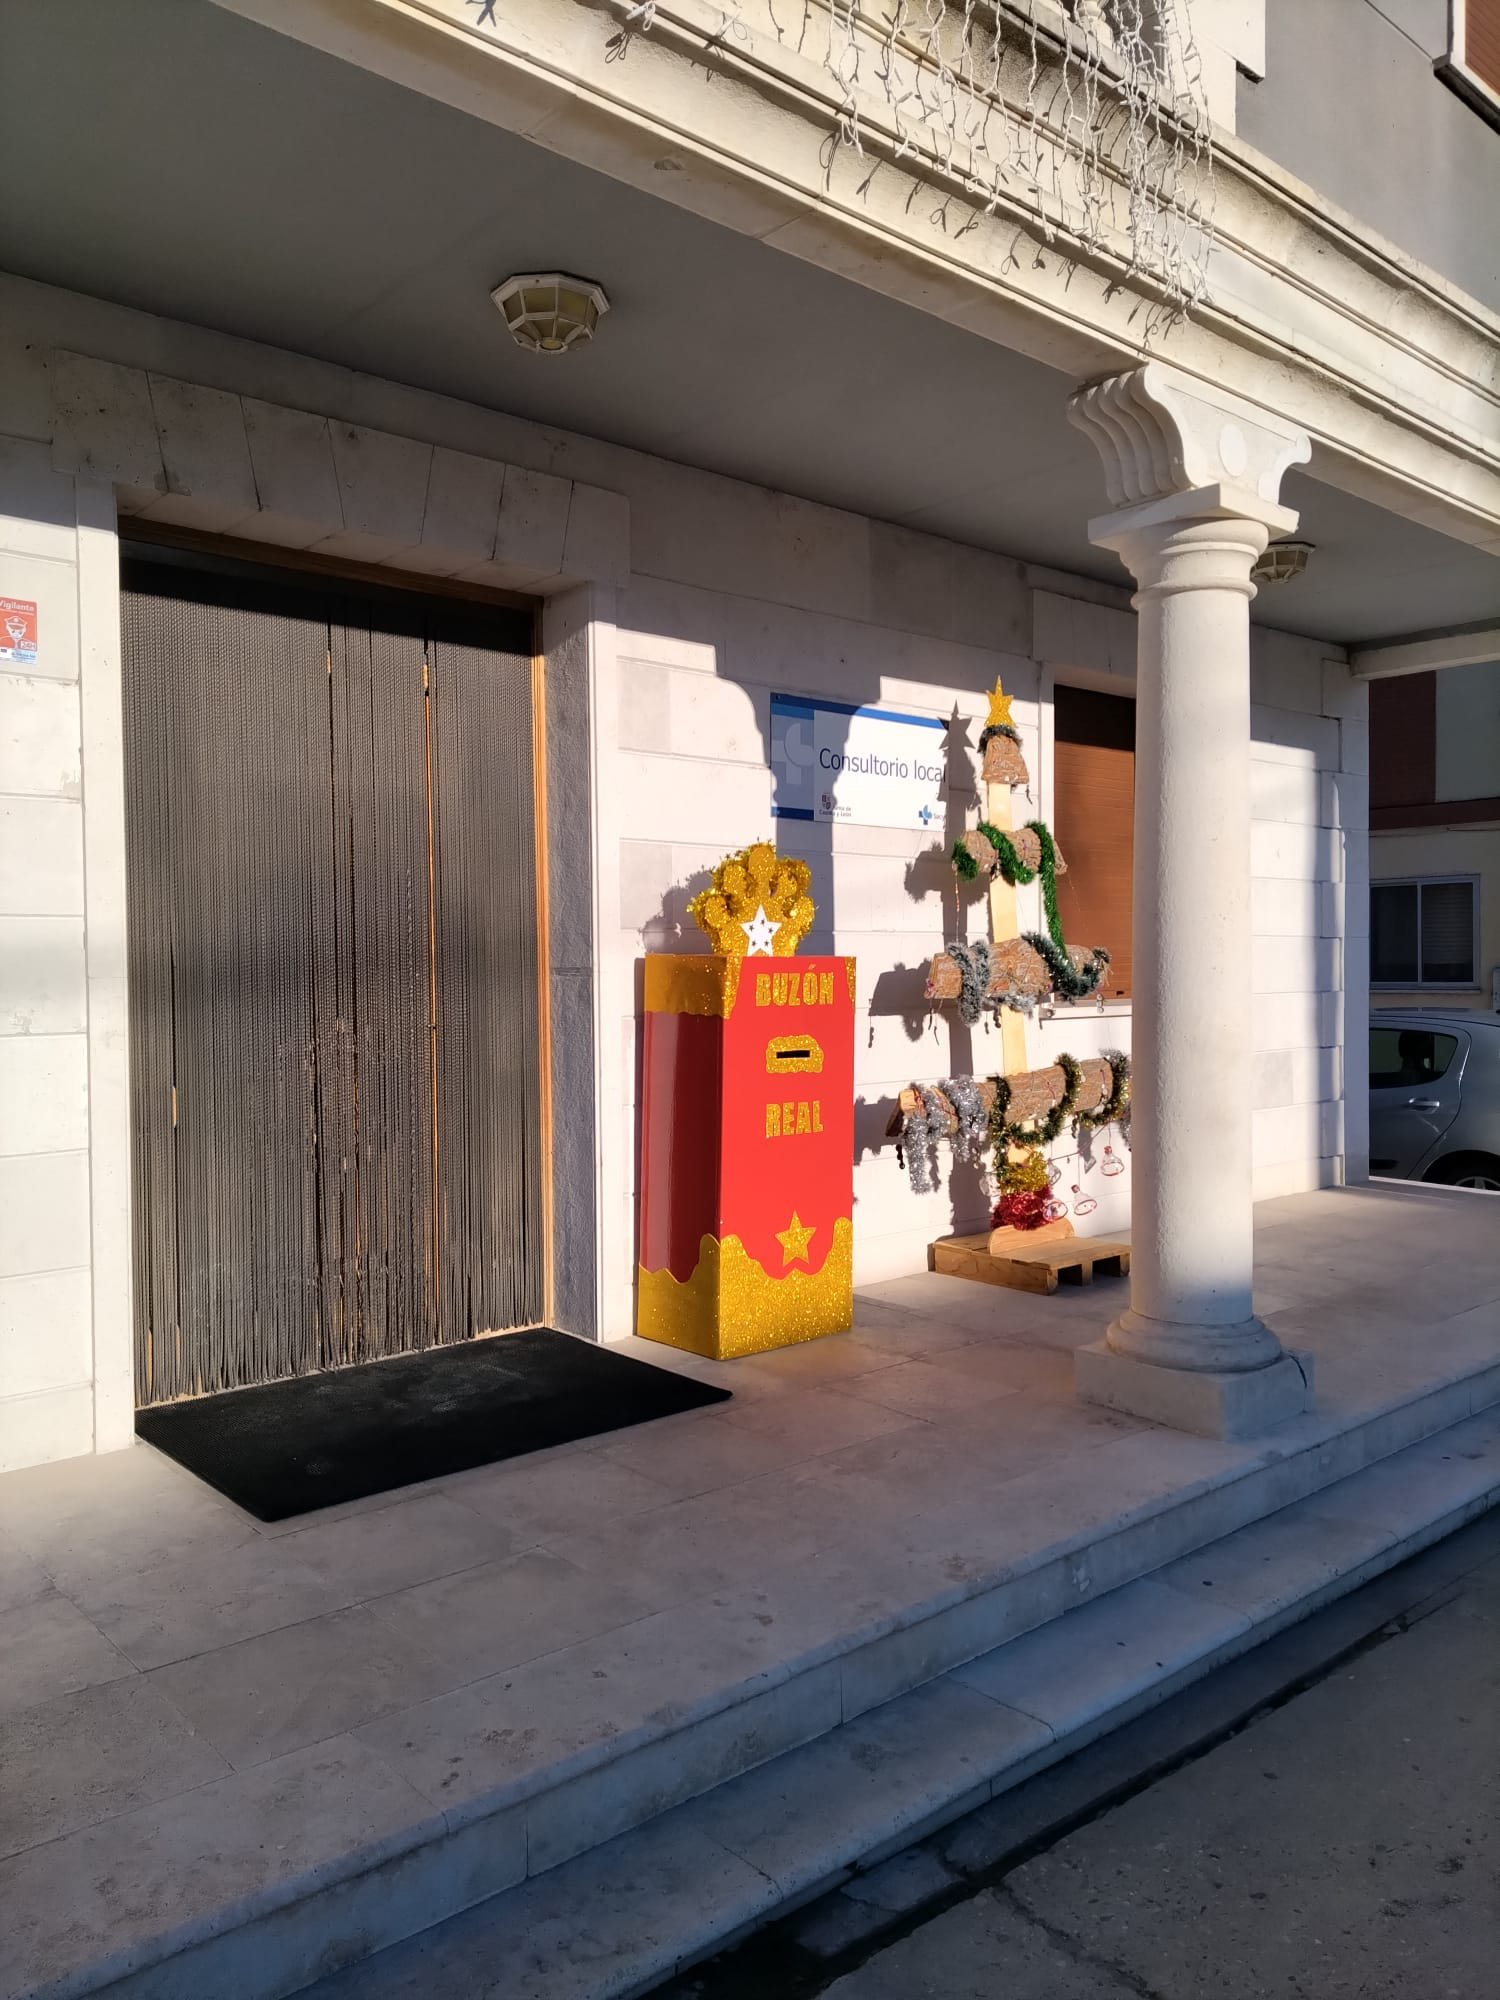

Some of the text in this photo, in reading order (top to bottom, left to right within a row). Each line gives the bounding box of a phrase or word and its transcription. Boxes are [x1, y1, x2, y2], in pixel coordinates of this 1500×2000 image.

[819, 748, 946, 783] Consultorio local
[755, 963, 835, 1007] BUZÓN
[765, 1100, 824, 1138] REAL
